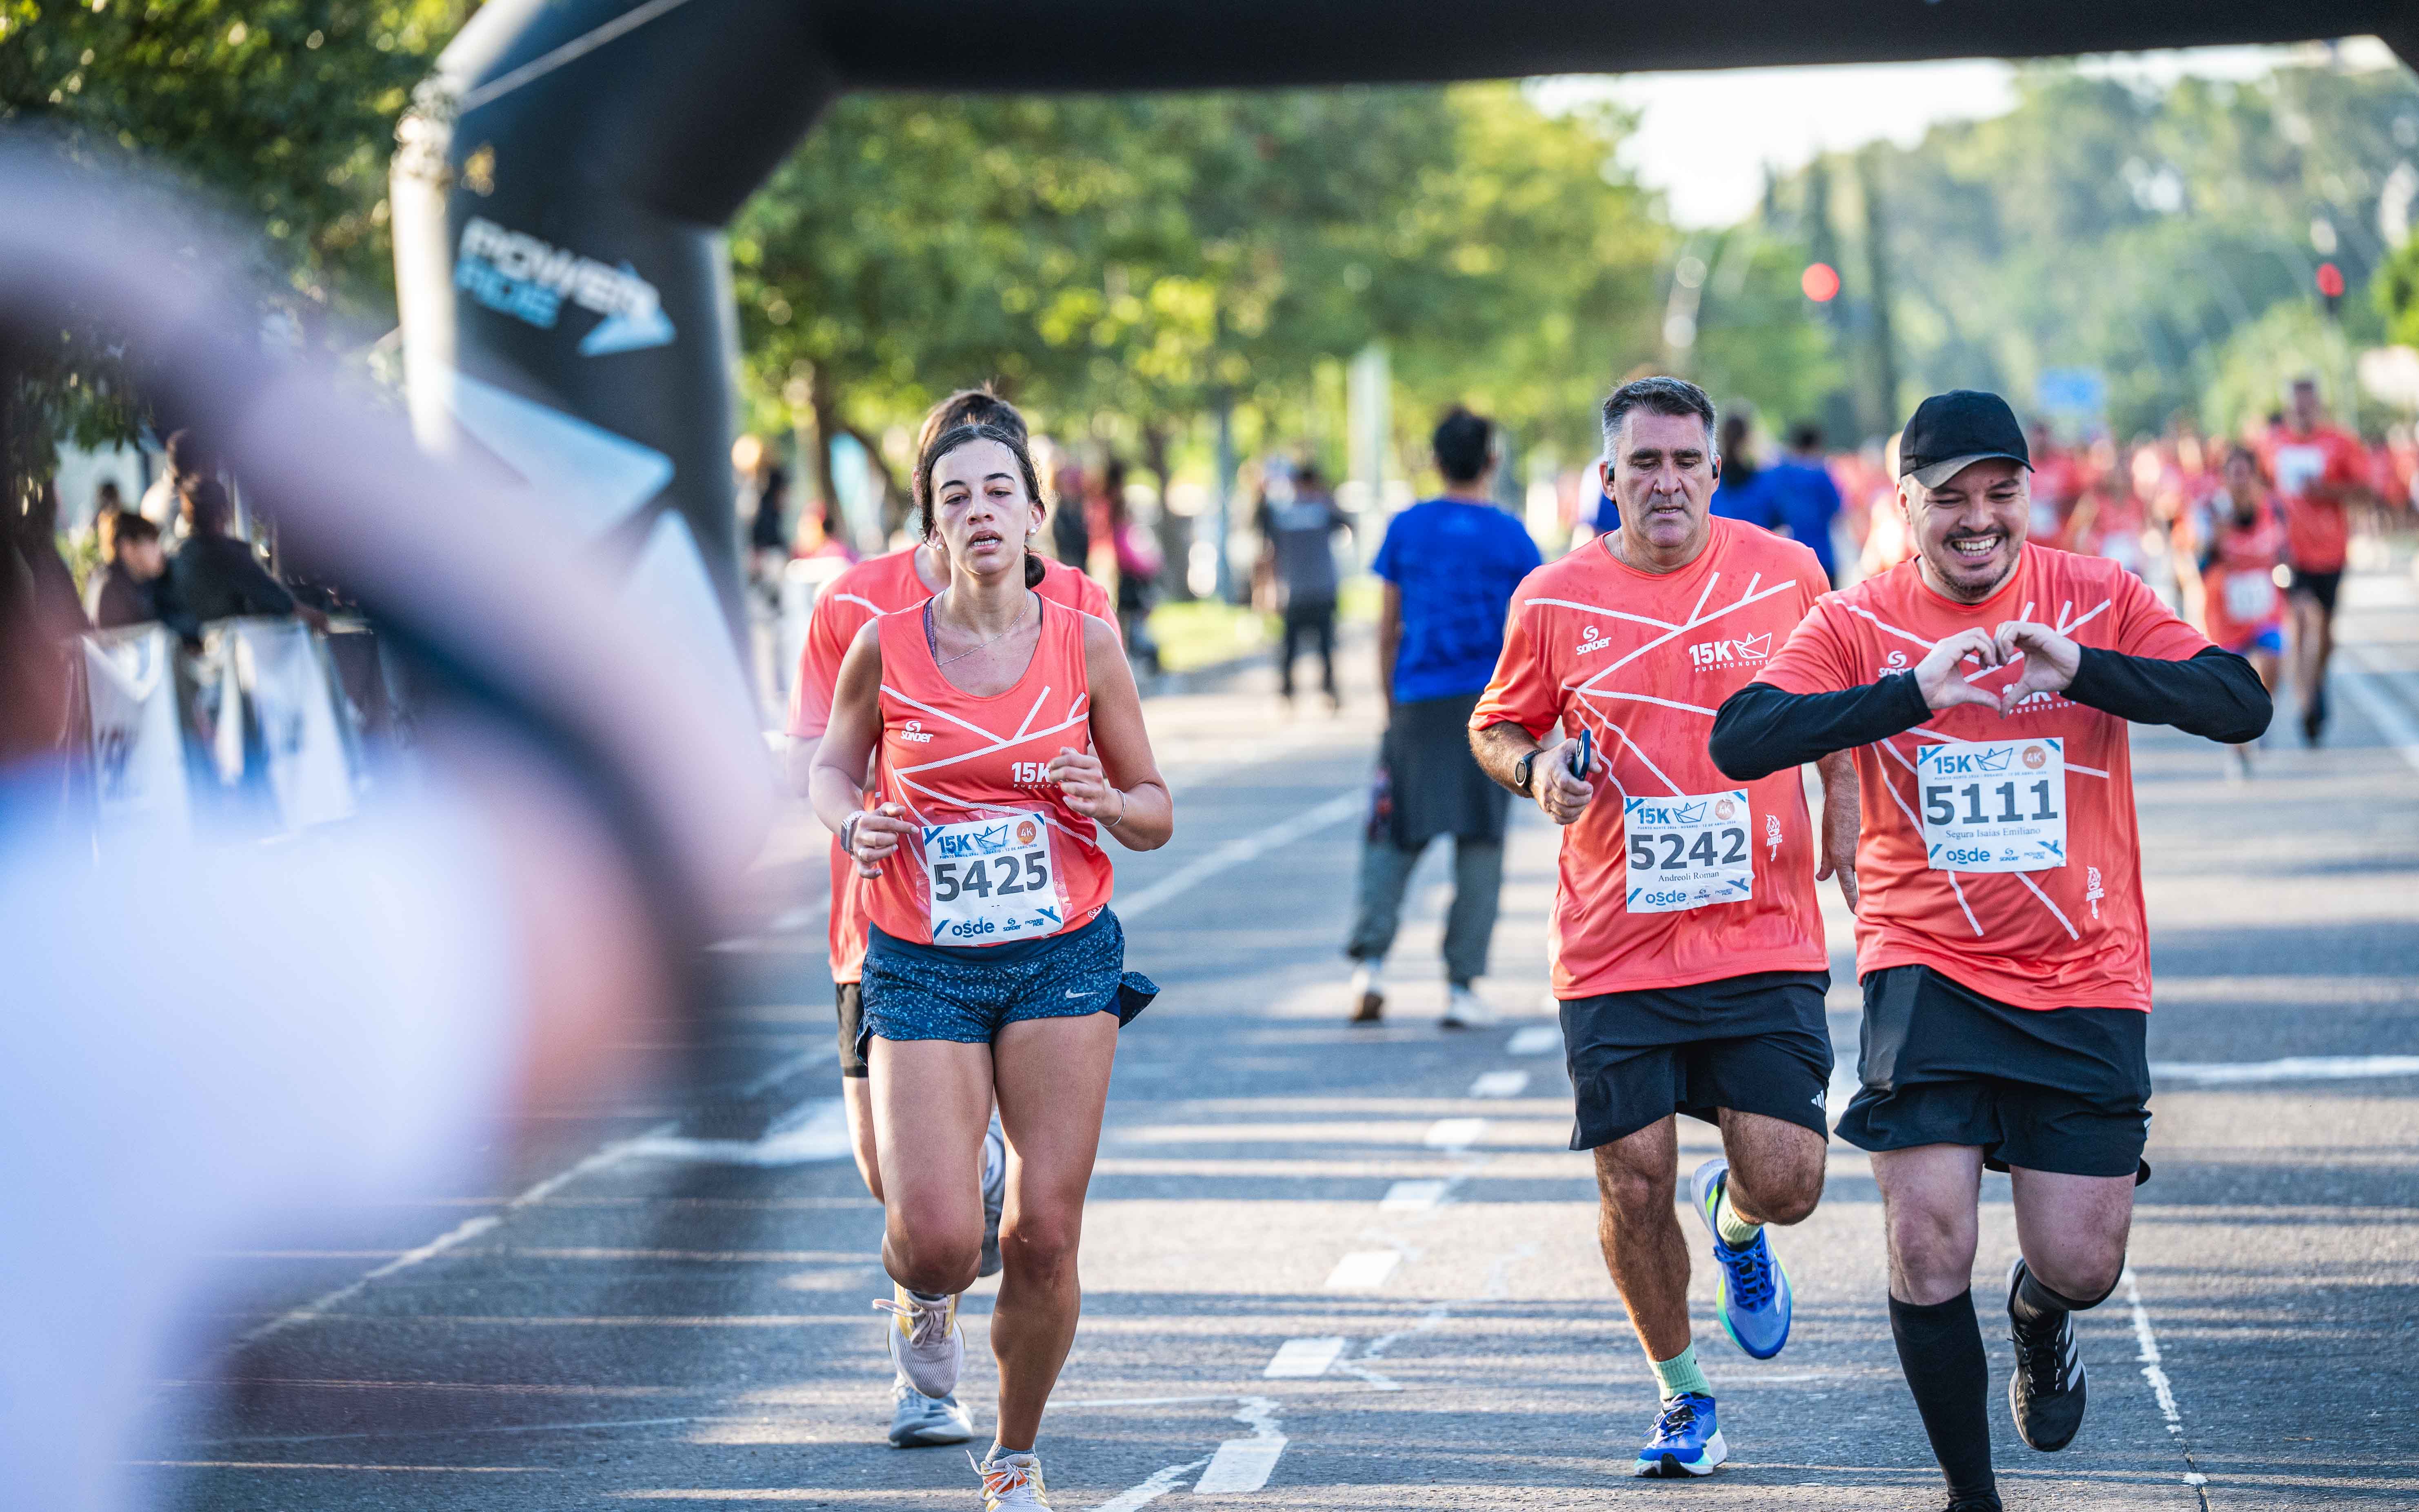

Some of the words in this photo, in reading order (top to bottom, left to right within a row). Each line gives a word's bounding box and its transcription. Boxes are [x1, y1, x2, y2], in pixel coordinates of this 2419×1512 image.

[1688, 640, 1734, 666] 15K
[1695, 663, 1734, 673] PUERTO
[1934, 755, 1972, 774] 15K
[2026, 753, 2041, 763] 4K
[1011, 762, 1050, 783] 15K
[1718, 806, 1731, 815] 4K
[1926, 779, 2058, 826] 5111
[1637, 808, 1670, 824] 15K
[1021, 828, 1033, 837] 4K
[1946, 830, 1974, 840] Segura
[2003, 827, 2041, 836] Emiliano
[937, 834, 973, 853] 15K
[1630, 828, 1746, 870] 5242
[1946, 848, 1990, 864] osde
[934, 850, 1047, 901] 5425
[1658, 873, 1691, 882] Andreoli
[1694, 871, 1719, 879] Roman
[1646, 890, 1687, 906] osde
[952, 919, 995, 937] osde
